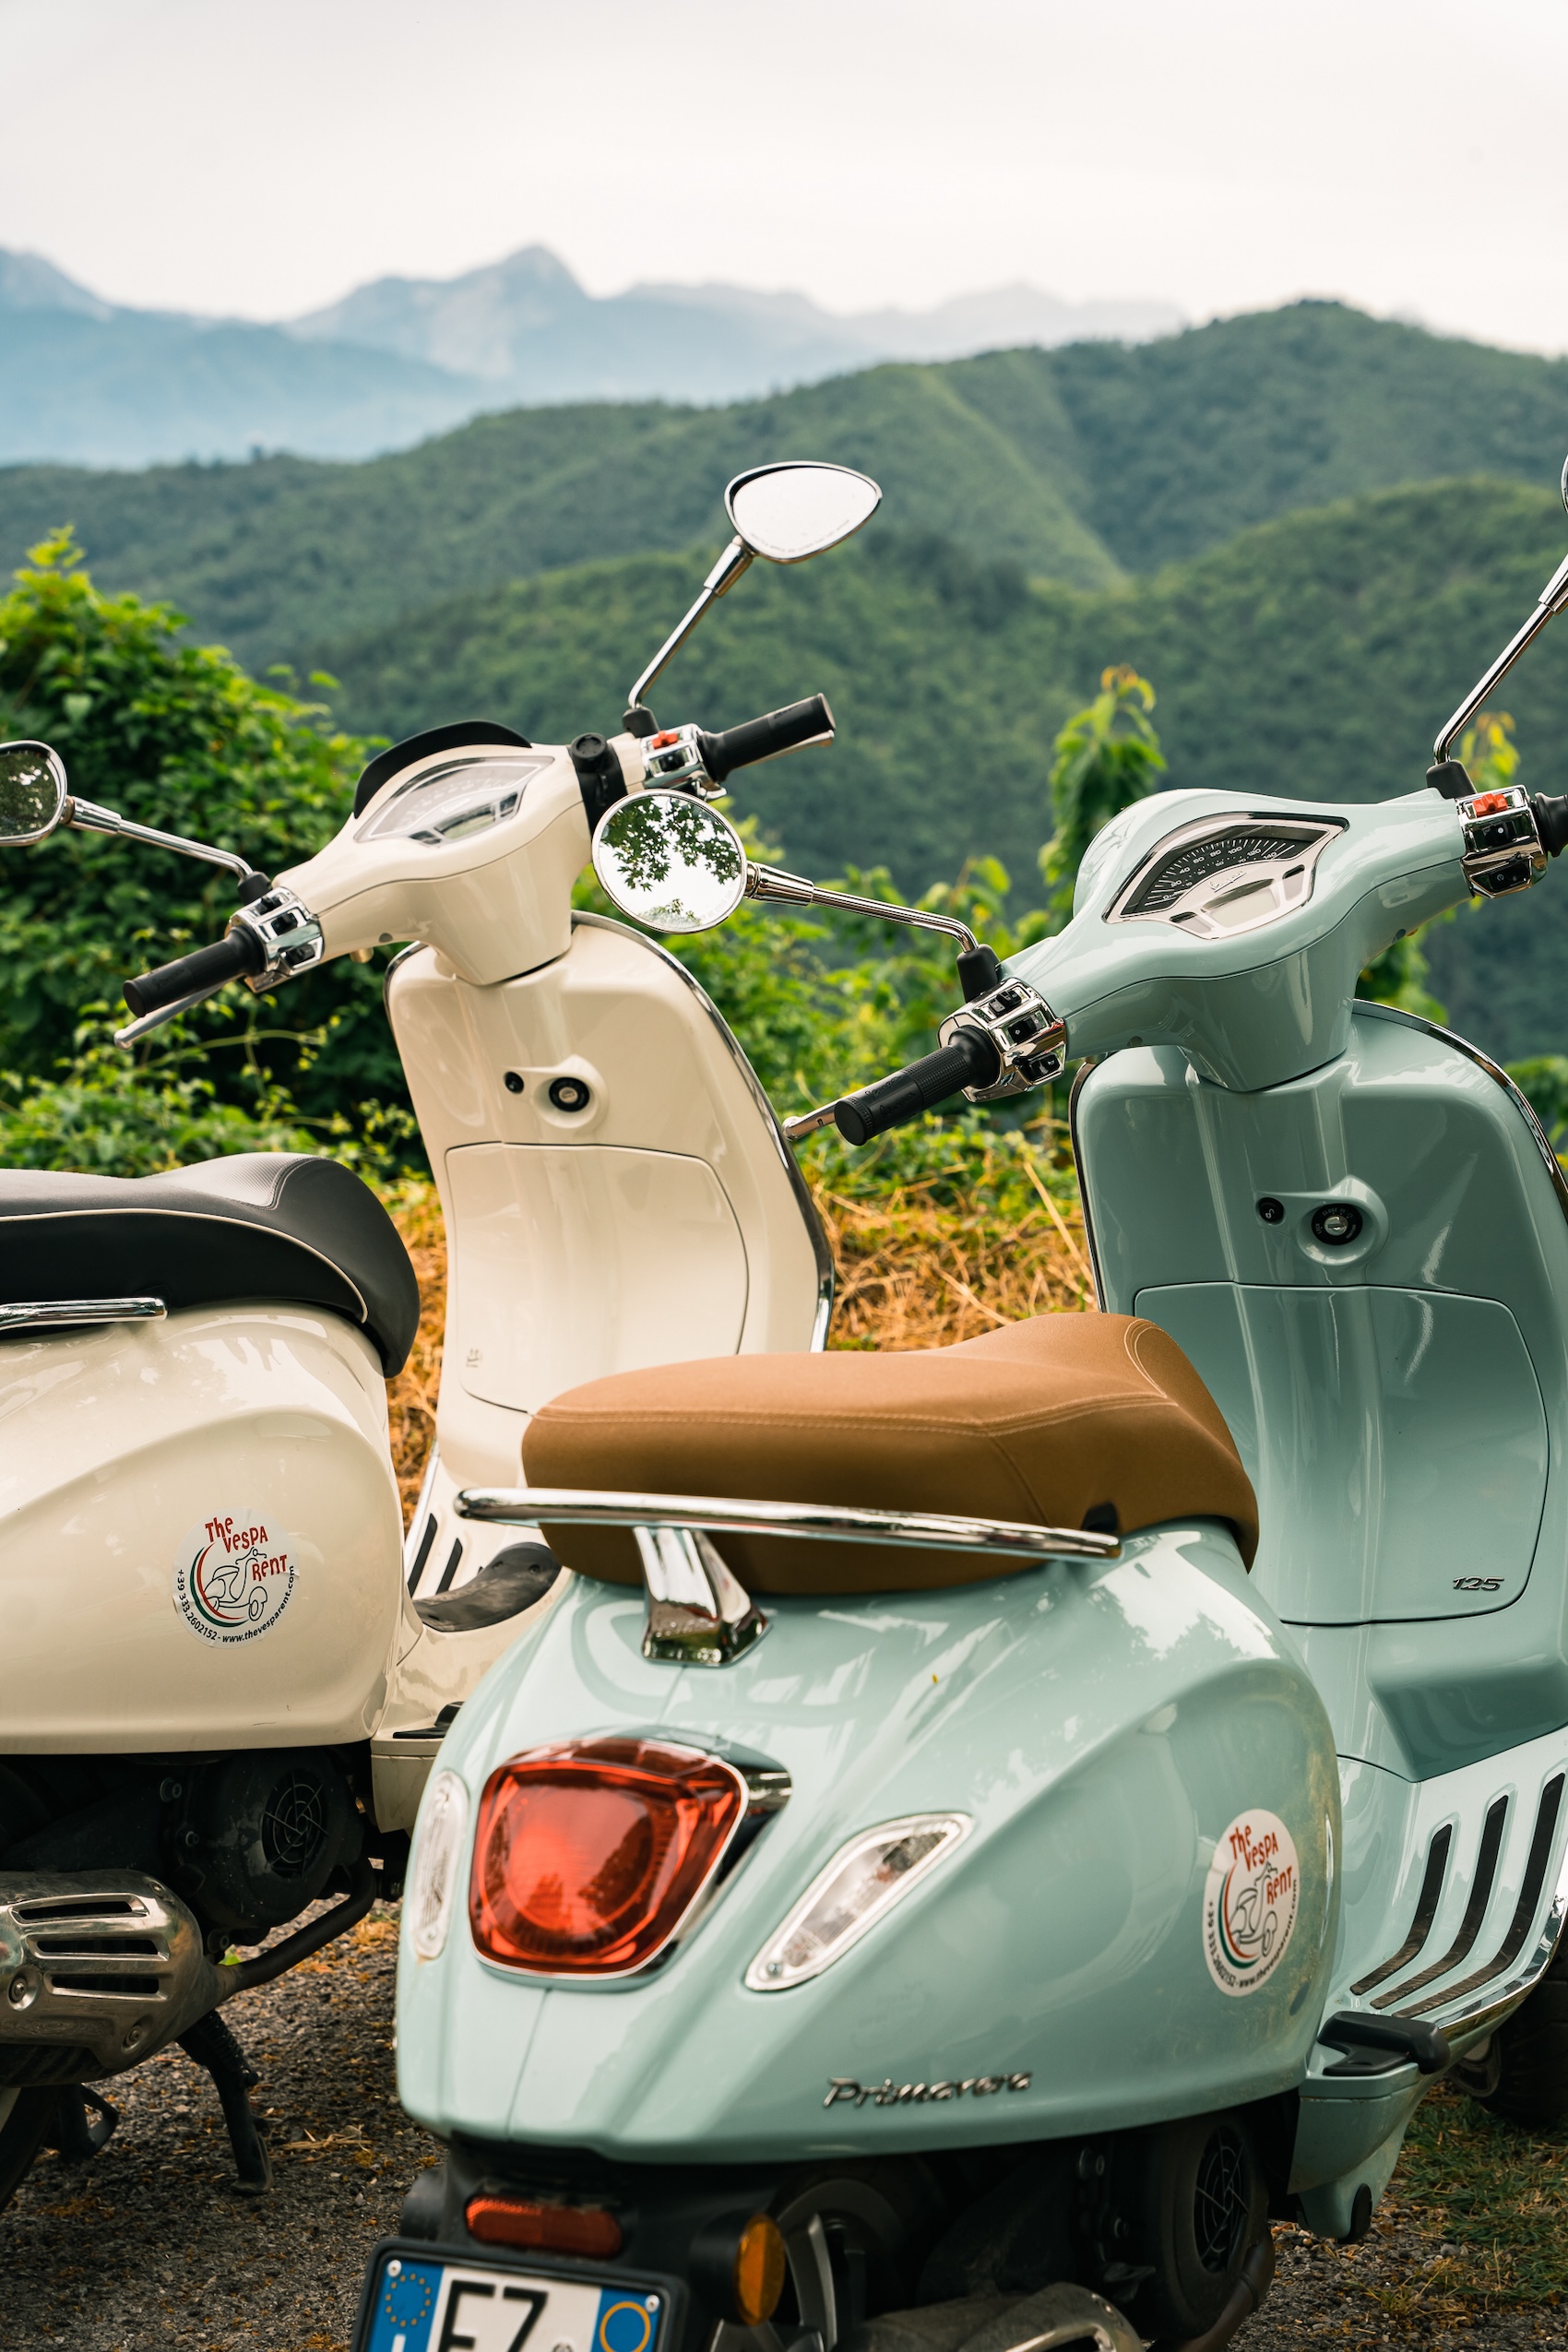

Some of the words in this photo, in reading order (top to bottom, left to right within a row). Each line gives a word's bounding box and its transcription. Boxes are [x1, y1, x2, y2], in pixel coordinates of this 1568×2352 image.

[1228, 847, 1242, 855] 100
[1247, 849, 1262, 857] 120
[1263, 851, 1277, 860] 140
[205, 1517, 233, 1543] The
[1453, 1576, 1505, 1592] 125
[179, 1593, 218, 1641] 333.2602152
[222, 1565, 294, 1643] www.thevesparent.com
[1229, 1824, 1252, 1860] The
[824, 2072, 1032, 2108] Primavera
